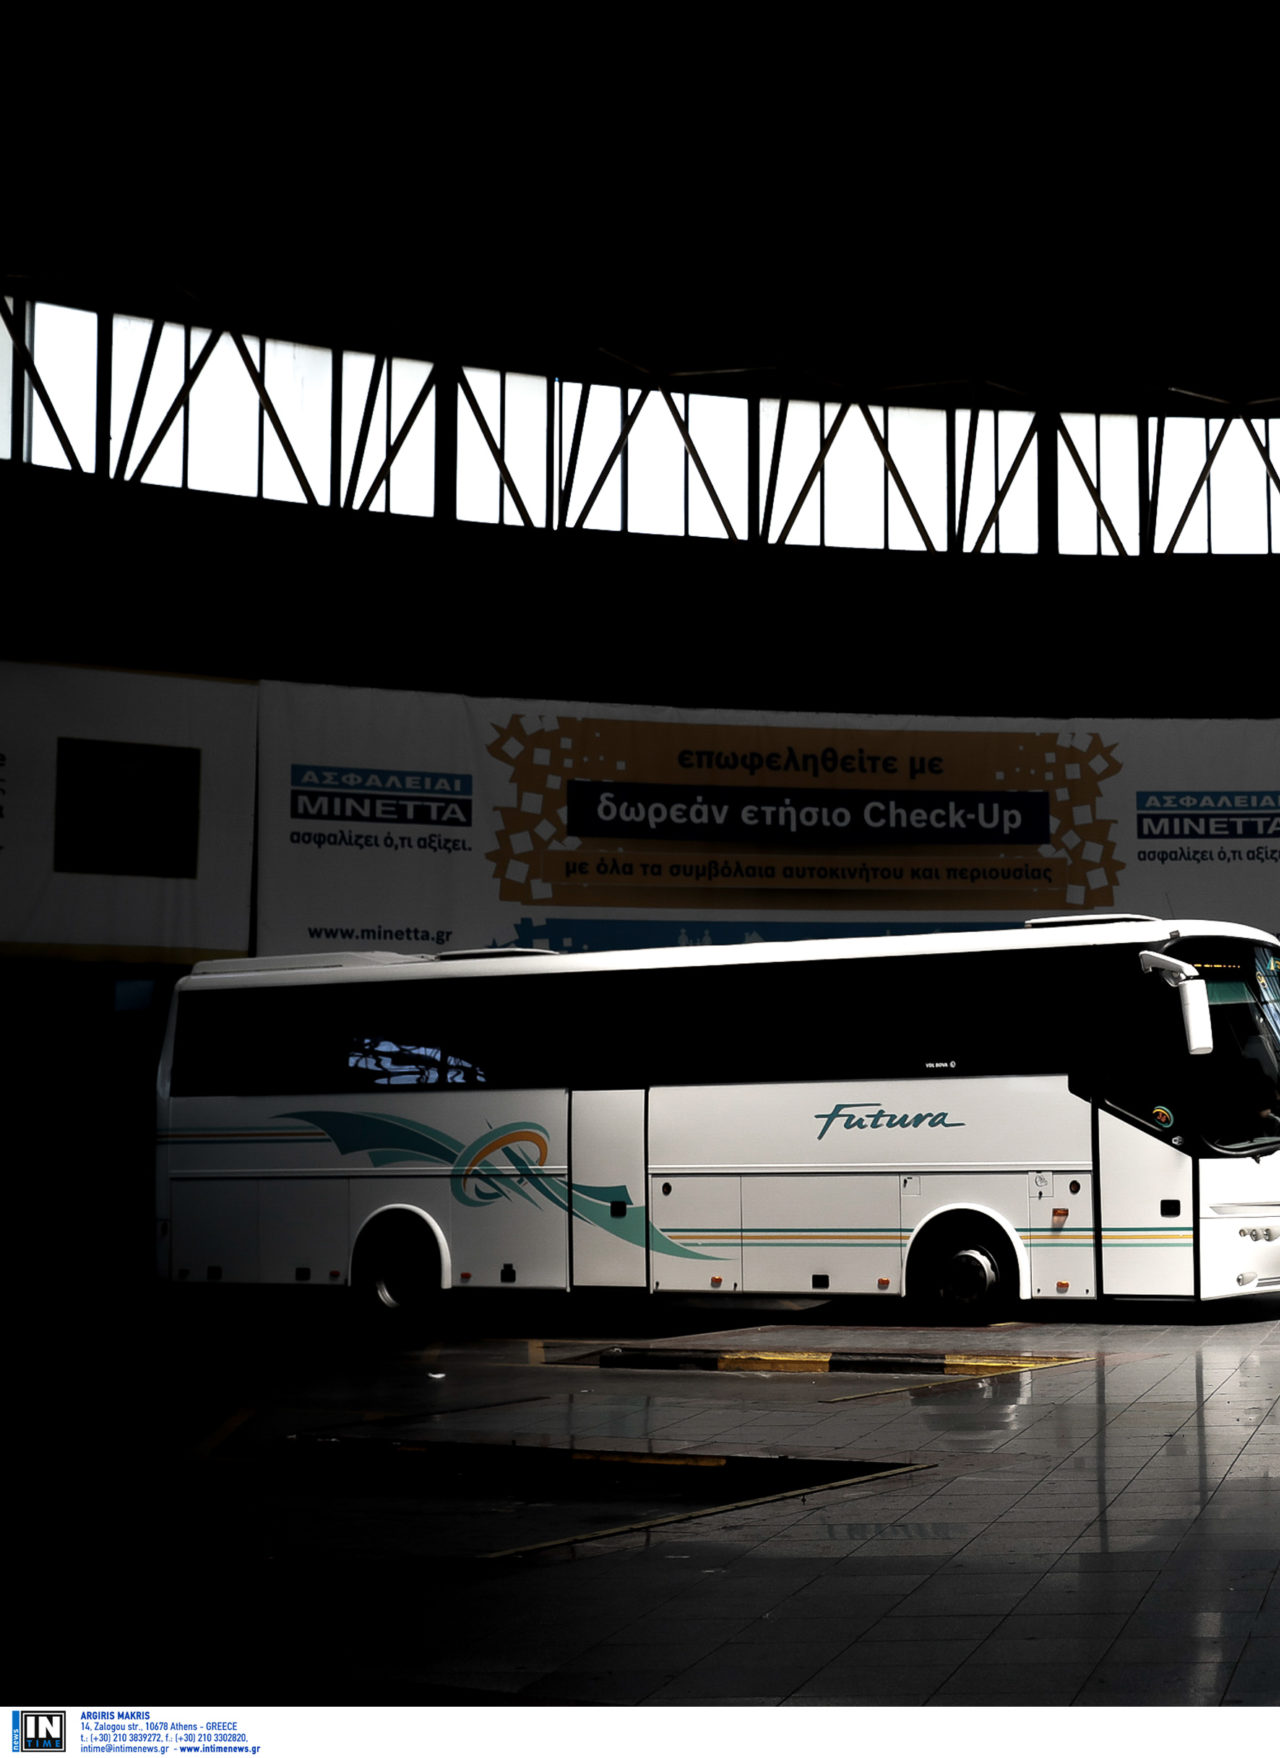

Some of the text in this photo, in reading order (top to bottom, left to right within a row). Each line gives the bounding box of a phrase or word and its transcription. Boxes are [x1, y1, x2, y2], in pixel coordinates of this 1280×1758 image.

[677, 748, 944, 780] επωφεληθείτε με
[300, 769, 462, 793] ΑΣΦΑΛΕΙΑΙ
[596, 792, 1023, 836] δωρεάν ετήσιο Check-Up
[289, 829, 473, 854] ασφαλίζει ό,τι αξίζει.
[1137, 846, 1215, 864] ασφαλίζει
[1217, 847, 1244, 864] ό,τι
[565, 858, 1053, 884] με όλα τα συμβόλαια αυτοκινήτου και περιουσίας
[308, 924, 453, 945] www.minetta.gr
[814, 1102, 967, 1141] Futura
